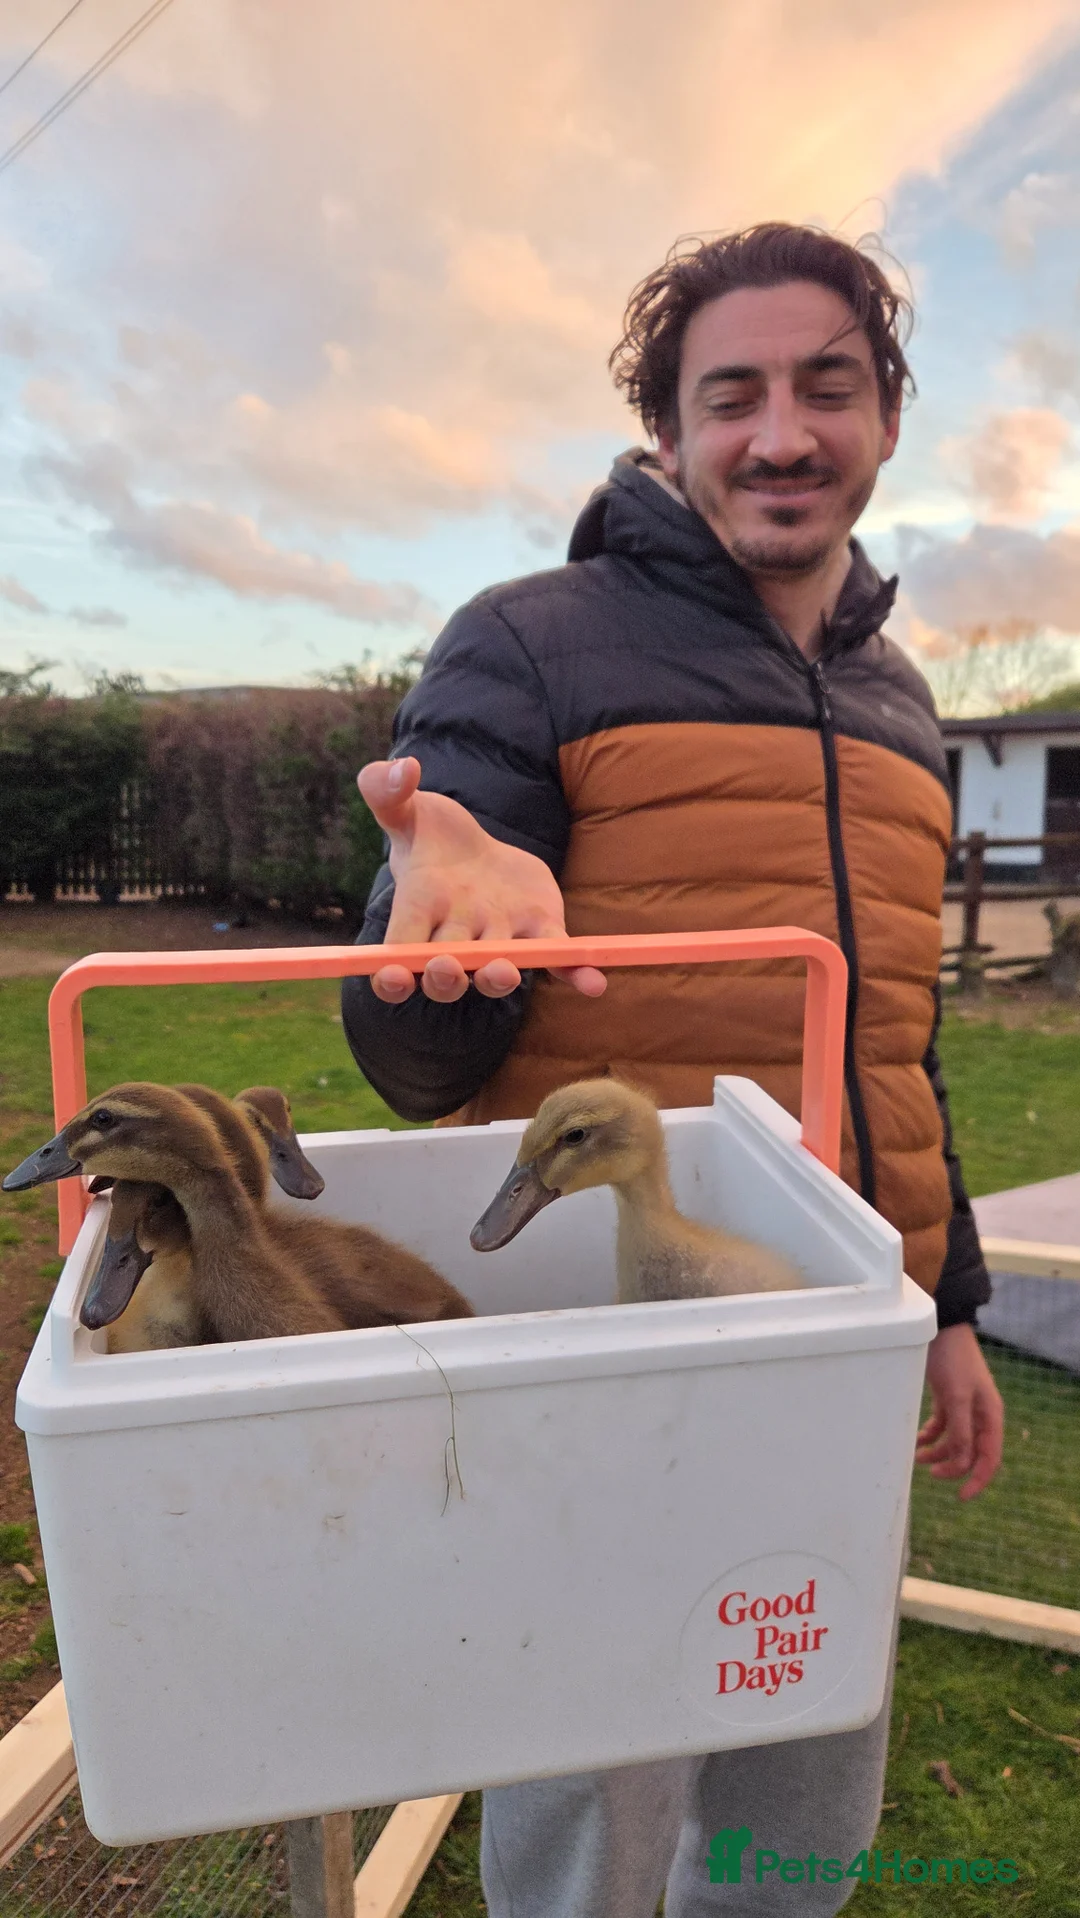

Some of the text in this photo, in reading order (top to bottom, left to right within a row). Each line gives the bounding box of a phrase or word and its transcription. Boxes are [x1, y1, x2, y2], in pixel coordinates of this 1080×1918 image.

[717, 1578, 816, 1626] Good
[754, 1621, 829, 1660] Pair
[715, 1659, 804, 1696] Days
